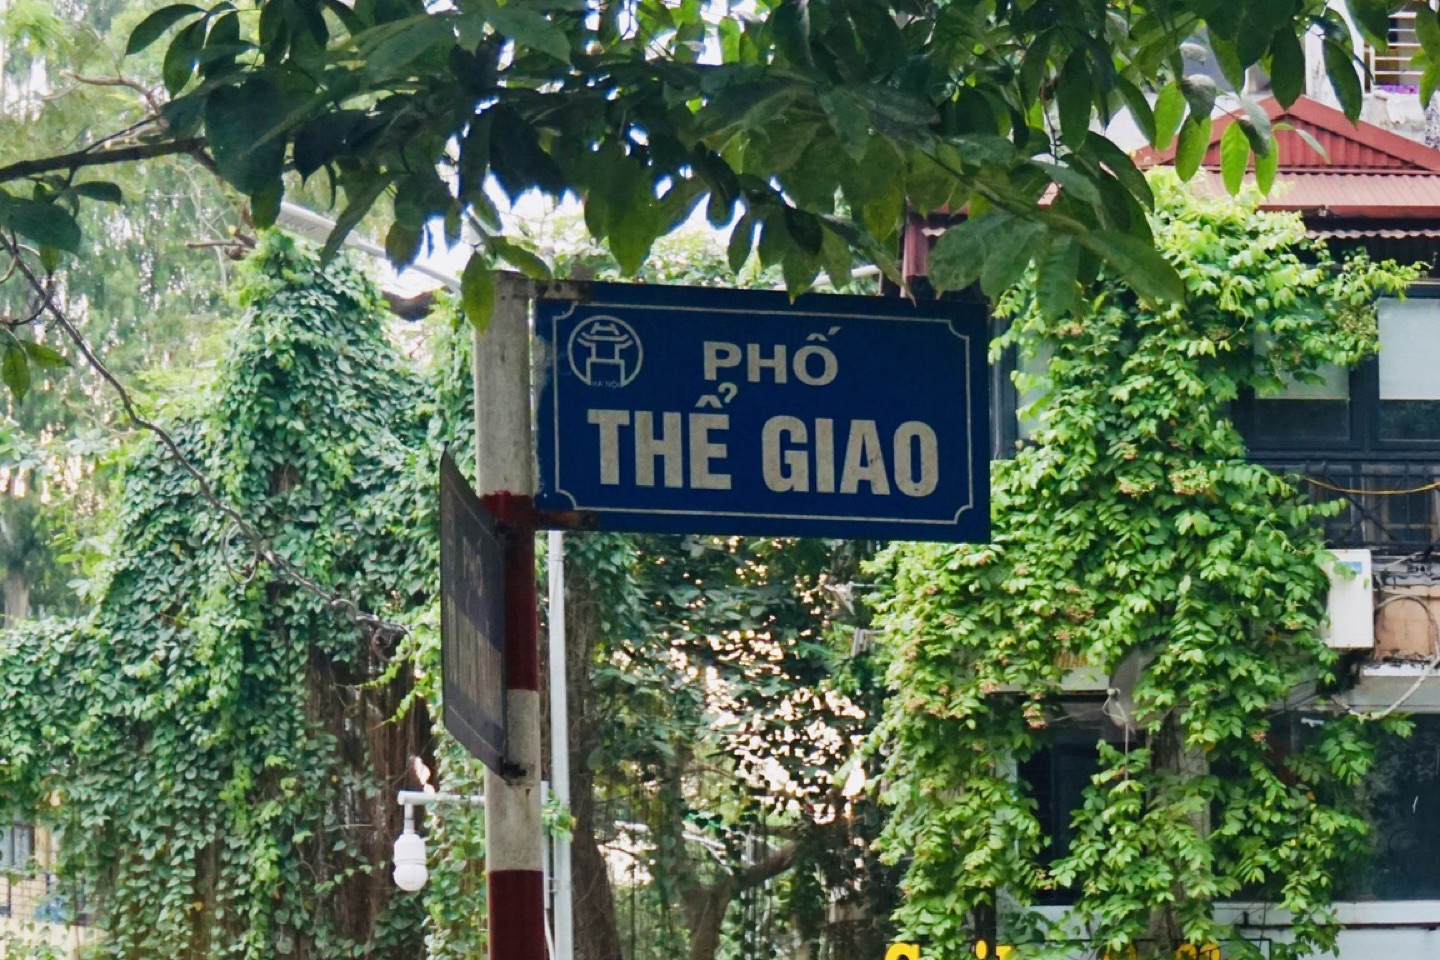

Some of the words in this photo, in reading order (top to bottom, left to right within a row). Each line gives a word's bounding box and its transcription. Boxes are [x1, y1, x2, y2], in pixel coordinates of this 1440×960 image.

[702, 325, 839, 387] PHỐ
[587, 382, 738, 490] THỂ
[760, 414, 939, 498] GIAO
